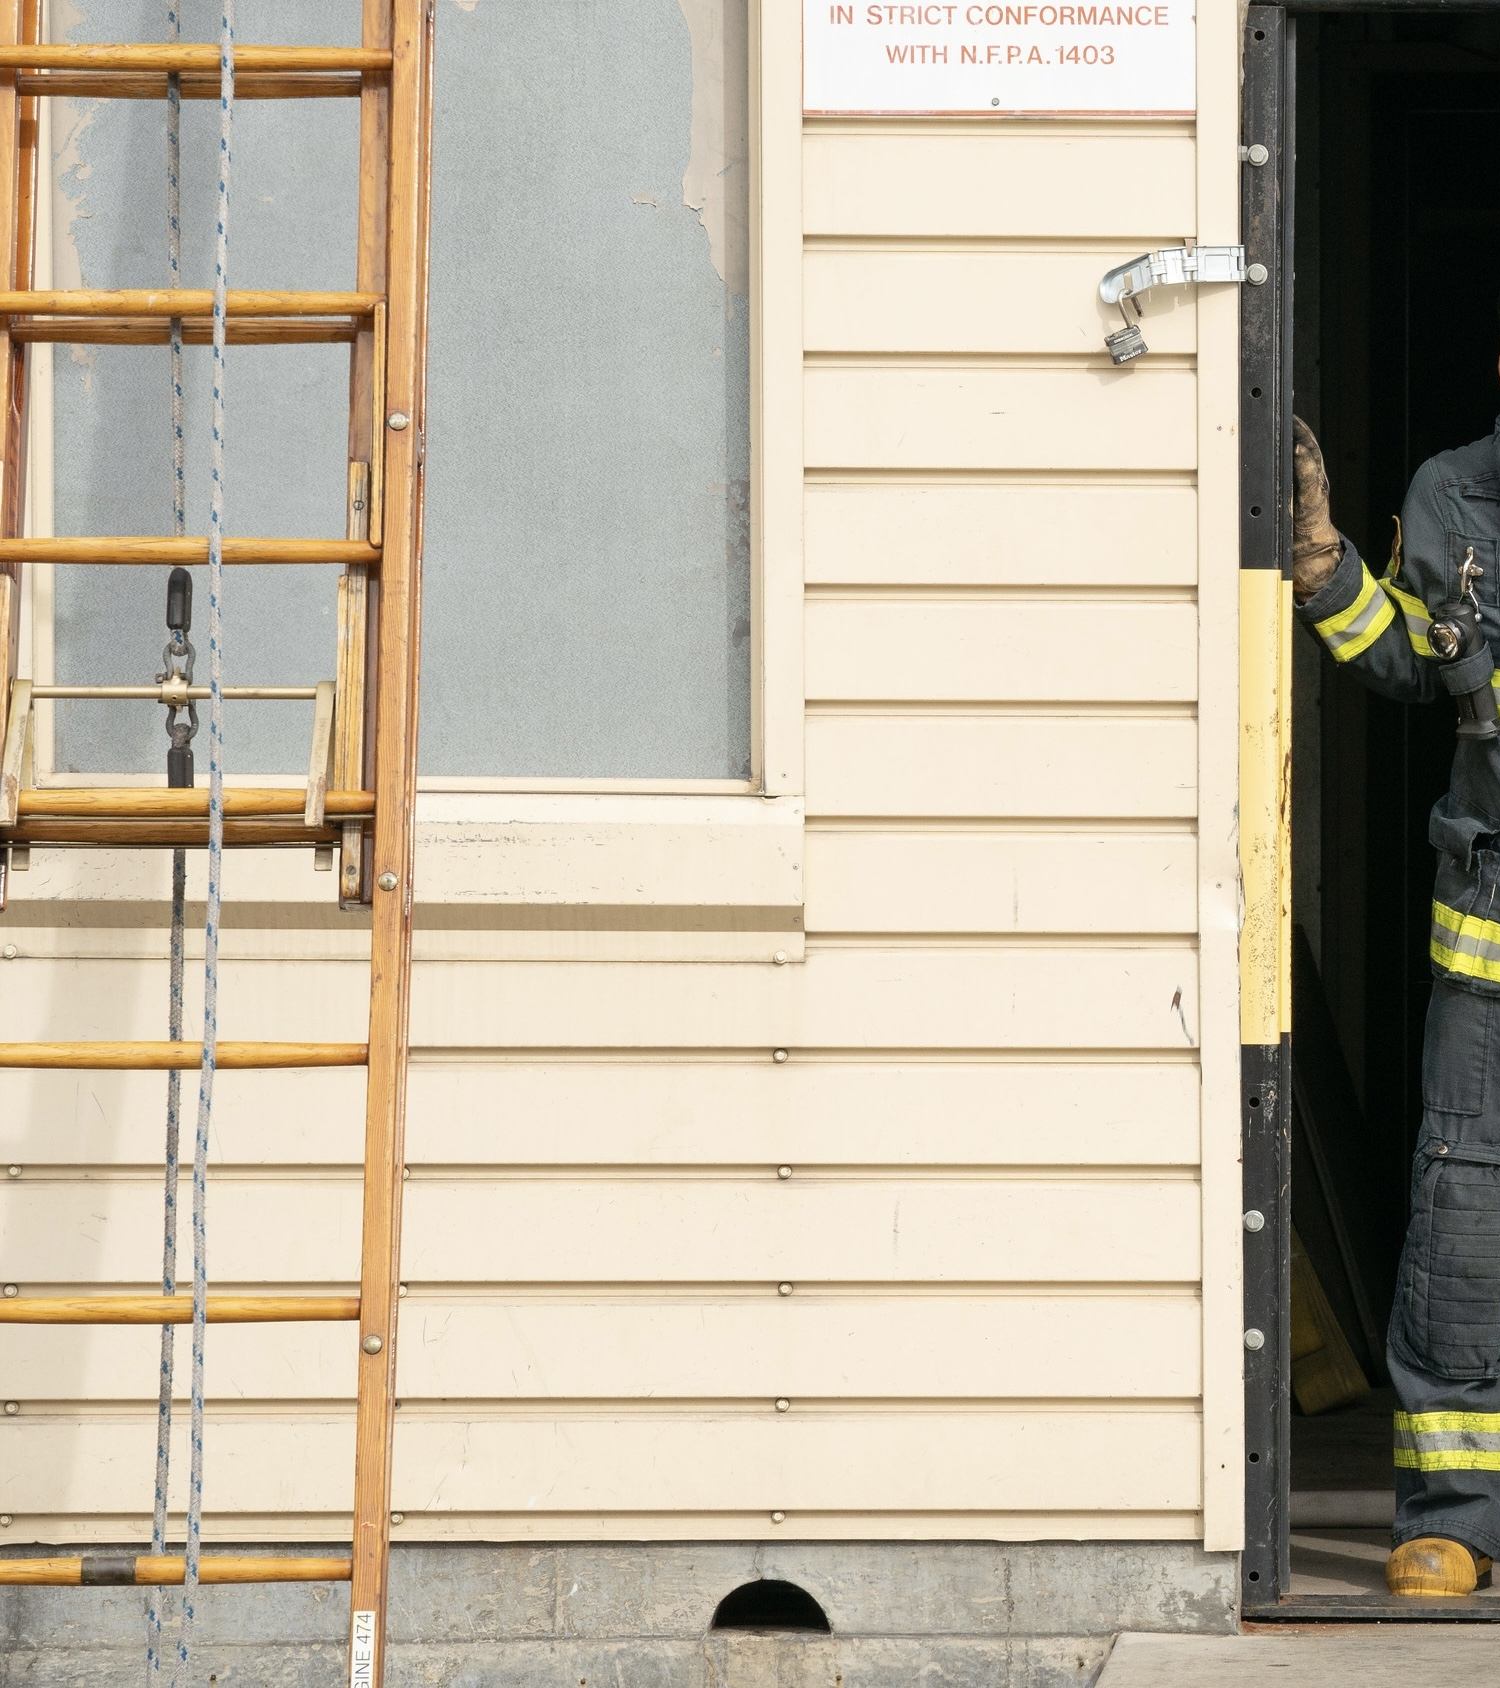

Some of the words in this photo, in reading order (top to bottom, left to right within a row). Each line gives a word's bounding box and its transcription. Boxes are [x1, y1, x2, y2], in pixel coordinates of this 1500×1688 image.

[829, 5, 854, 26] IN
[866, 5, 957, 26] STRICT
[965, 5, 1170, 26] CONFORMANCE
[886, 44, 948, 65] WITH
[1119, 350, 1142, 362] Master
[356, 1614, 372, 1644] 474
